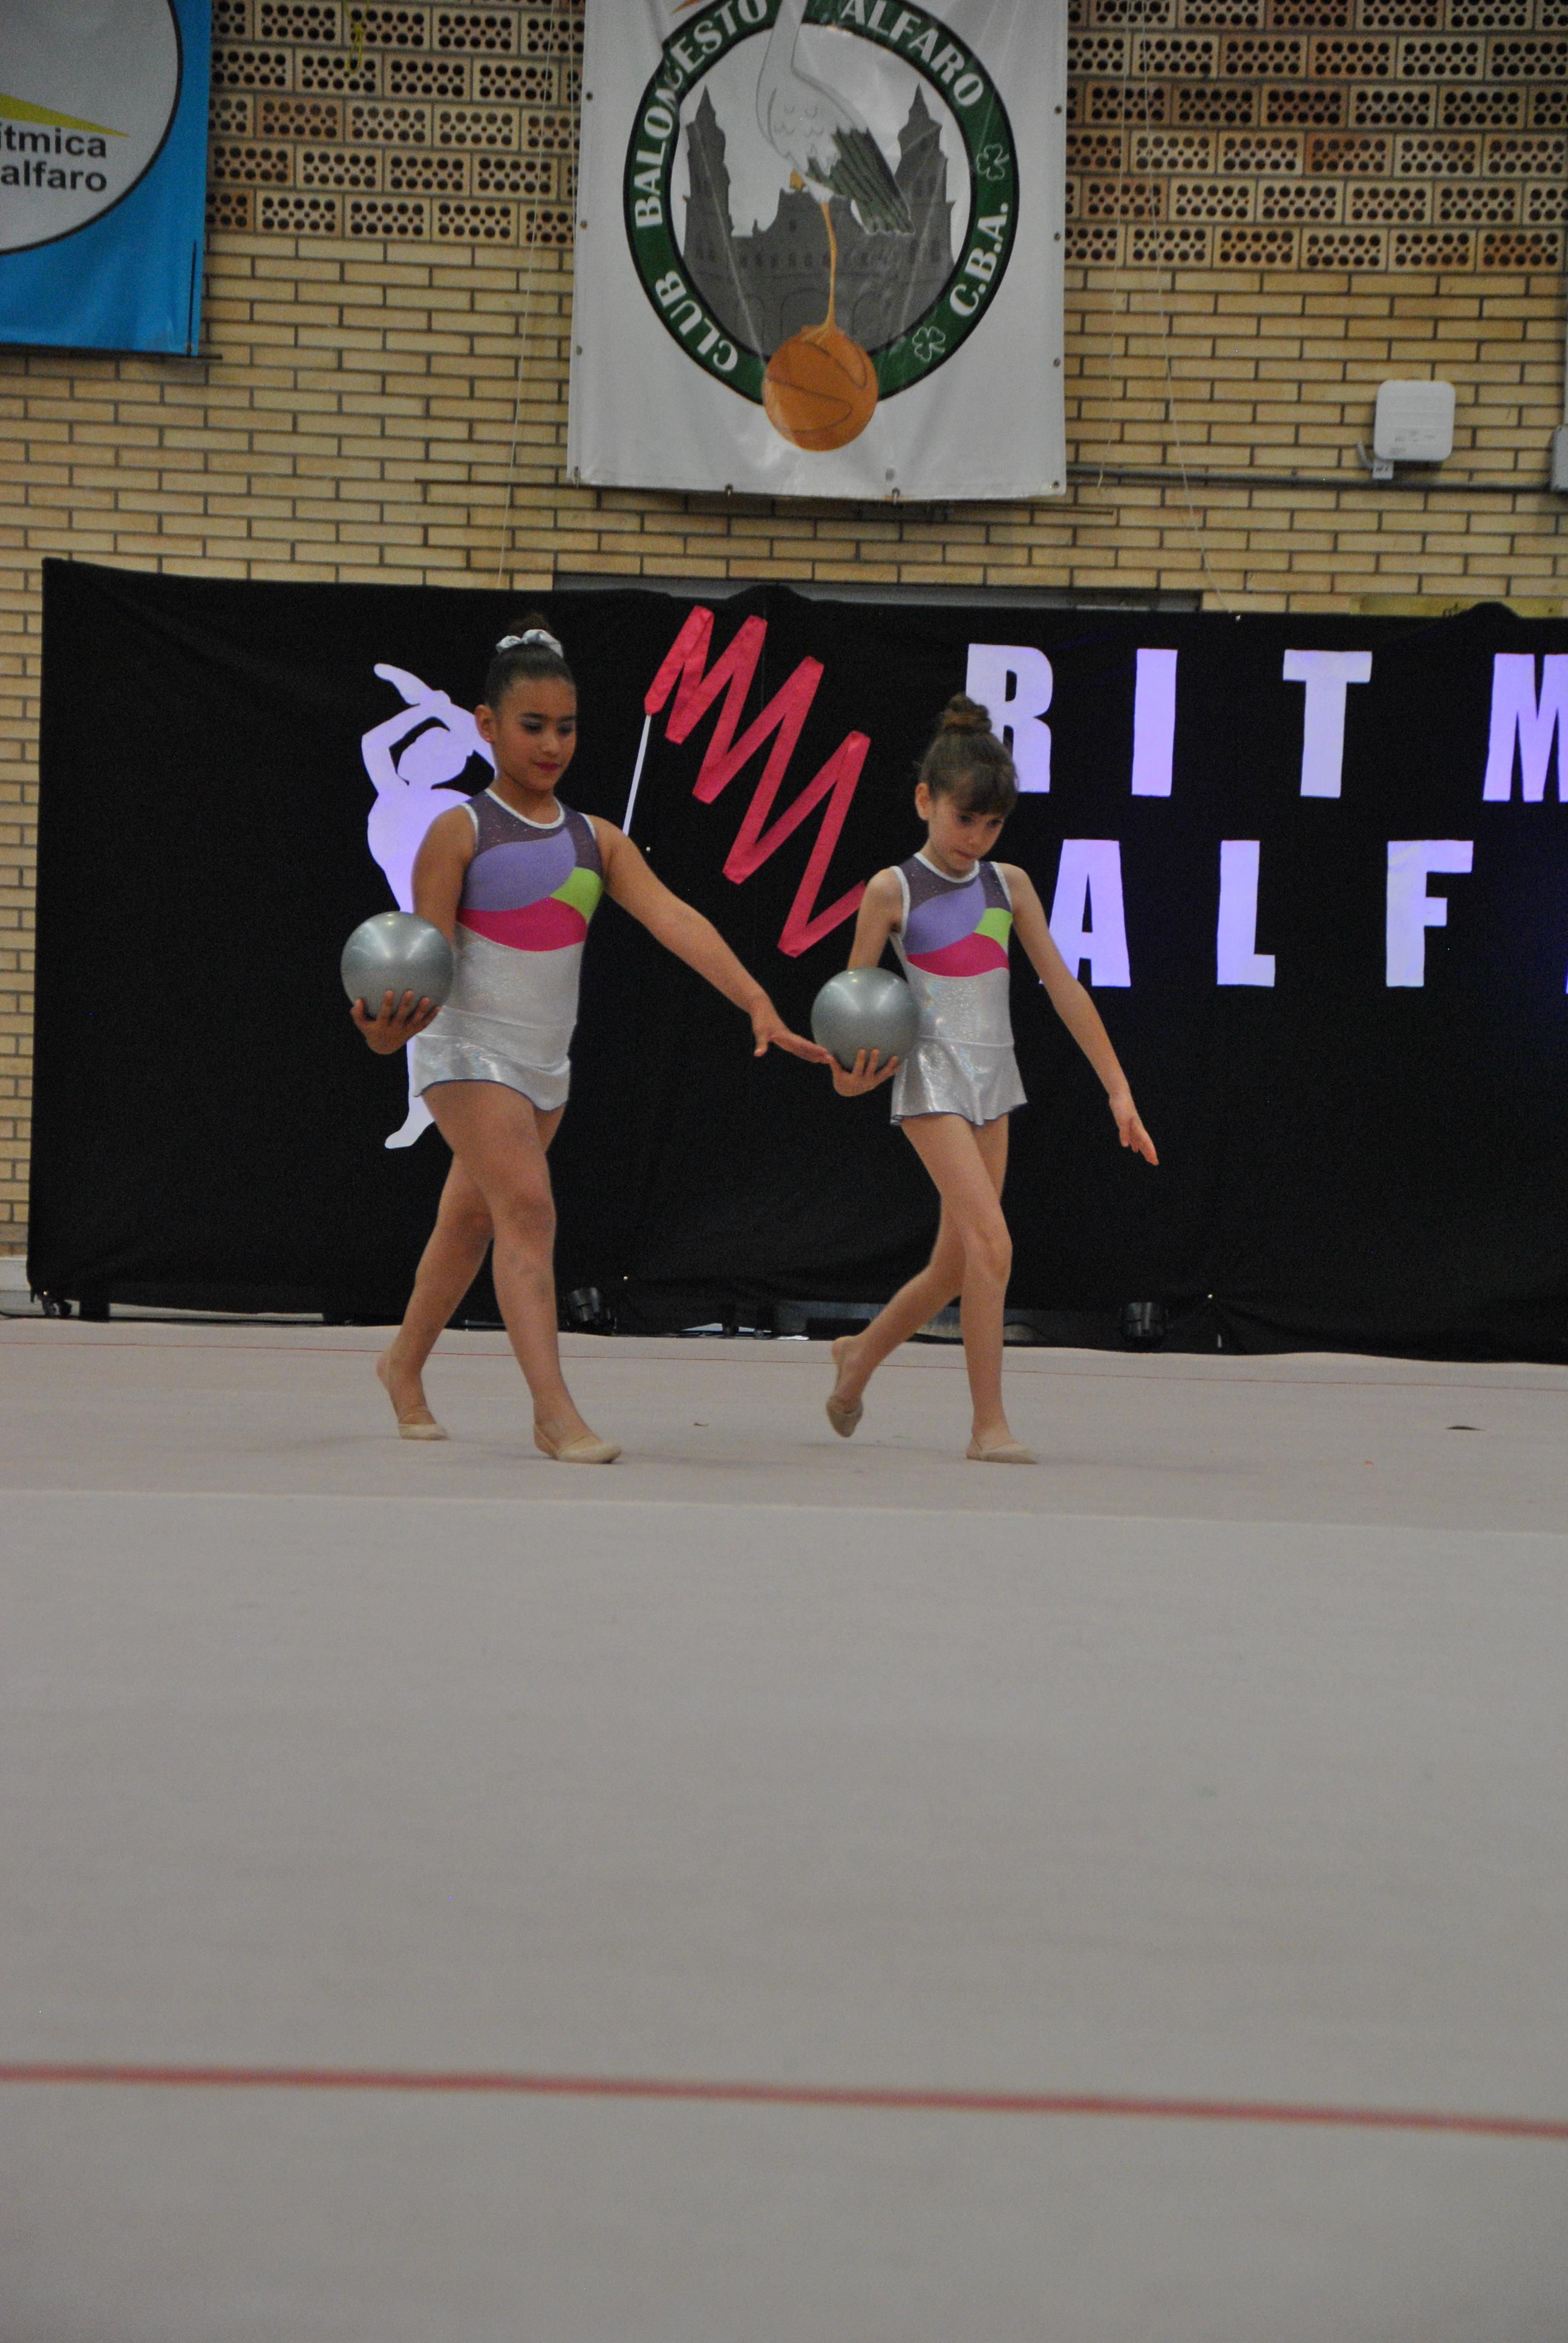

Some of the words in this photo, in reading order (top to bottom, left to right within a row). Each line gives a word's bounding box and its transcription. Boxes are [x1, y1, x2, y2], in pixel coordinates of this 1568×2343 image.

[0, 160, 108, 192] alfaro
[655, 270, 738, 372] CLUB
[840, 0, 984, 106] ALFARO
[950, 203, 1009, 316] C.B.A.
[1039, 839, 1568, 994] ALF
